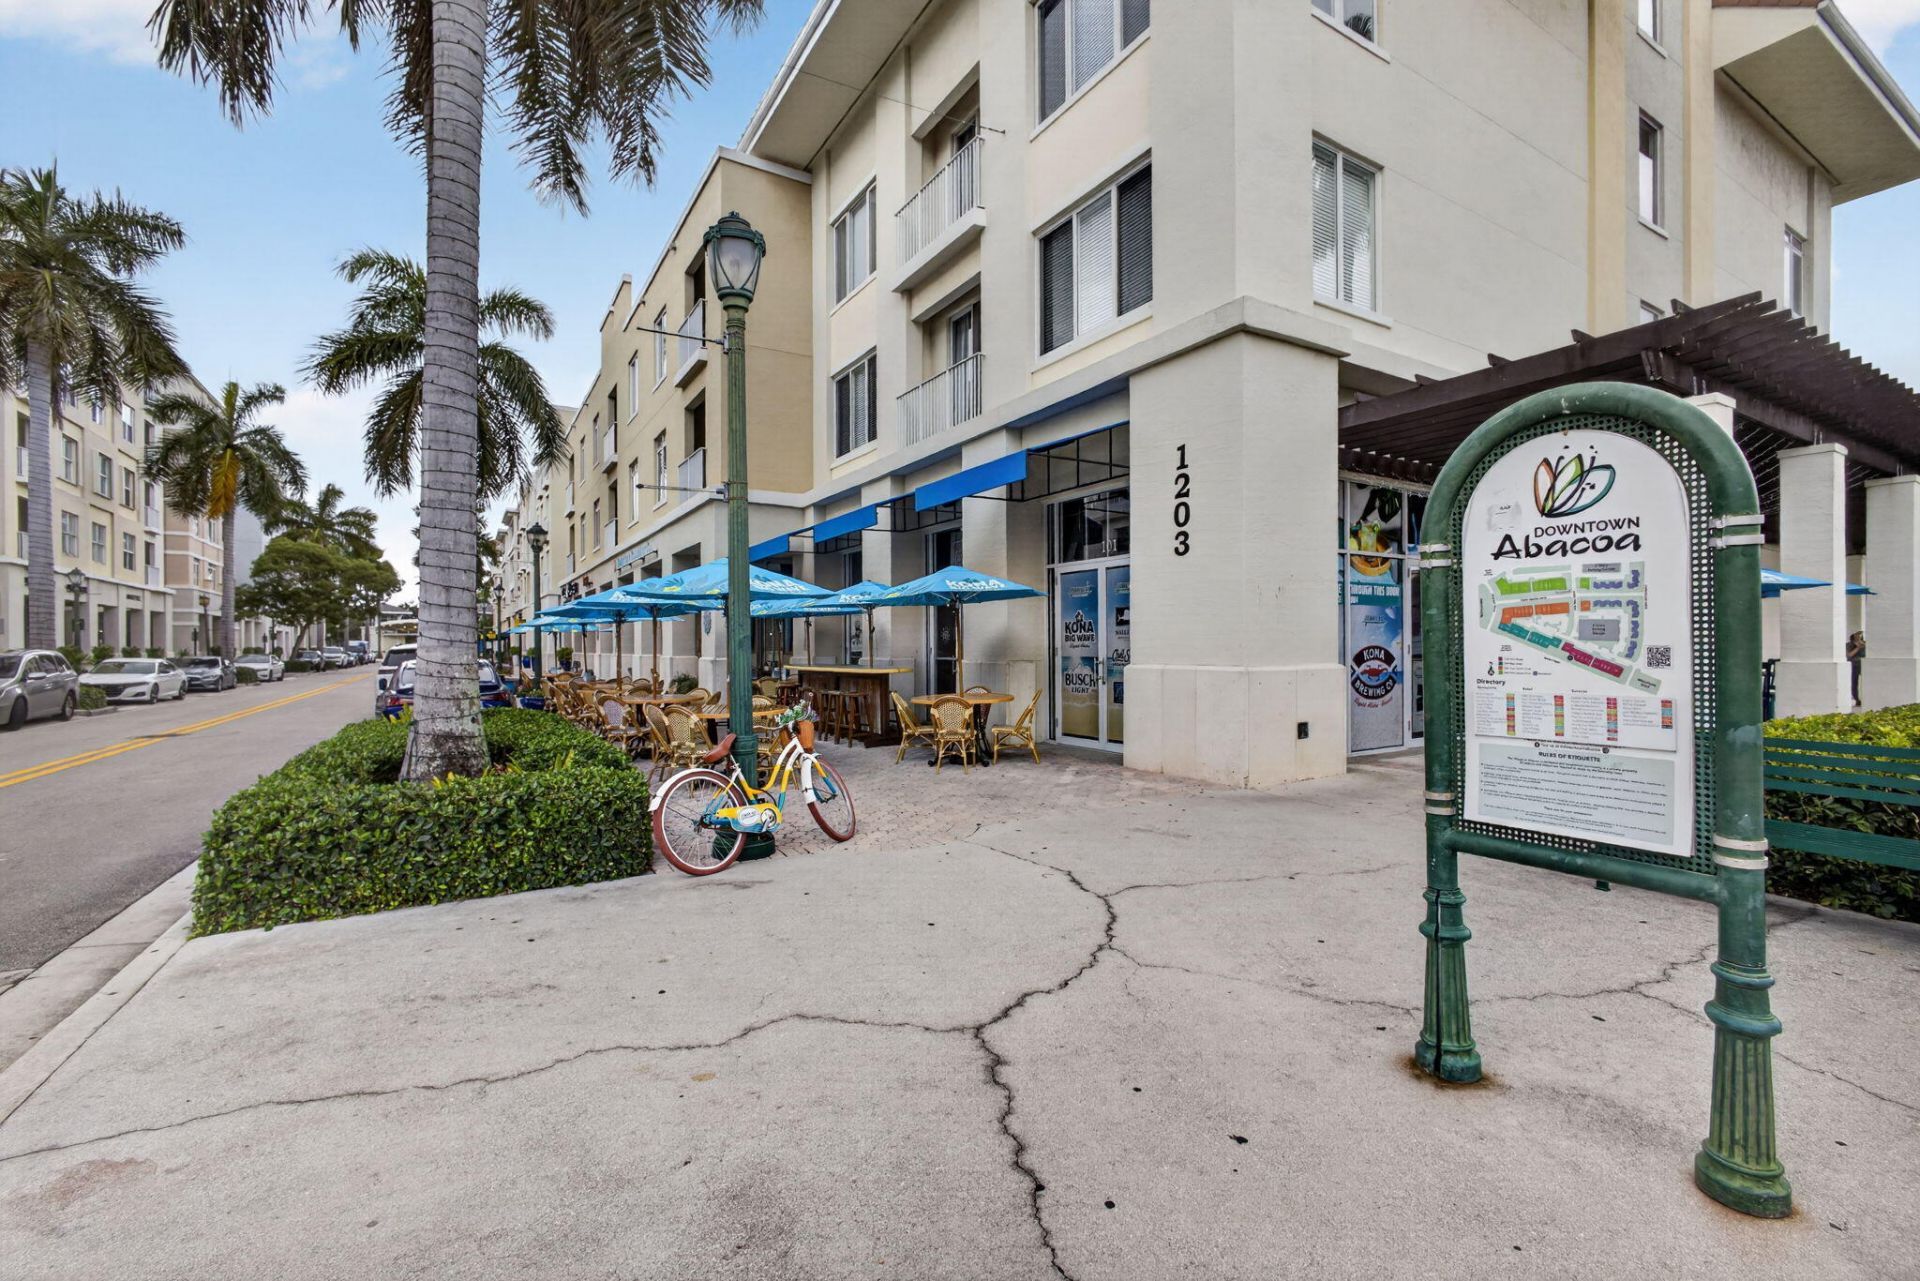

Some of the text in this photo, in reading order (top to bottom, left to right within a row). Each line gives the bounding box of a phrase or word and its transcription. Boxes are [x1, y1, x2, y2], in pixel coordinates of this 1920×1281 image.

[1174, 443, 1191, 557] 1203
[1534, 516, 1640, 538] DOWNTOWN
[1491, 532, 1642, 560] Abacoa
[1065, 620, 1094, 634] KONA
[1064, 633, 1095, 642] BIG WAVE
[1363, 648, 1385, 661] KONA
[1065, 673, 1096, 688] BUSCH
[1354, 679, 1386, 697] BREWING
[1476, 678, 1506, 686] Directory
